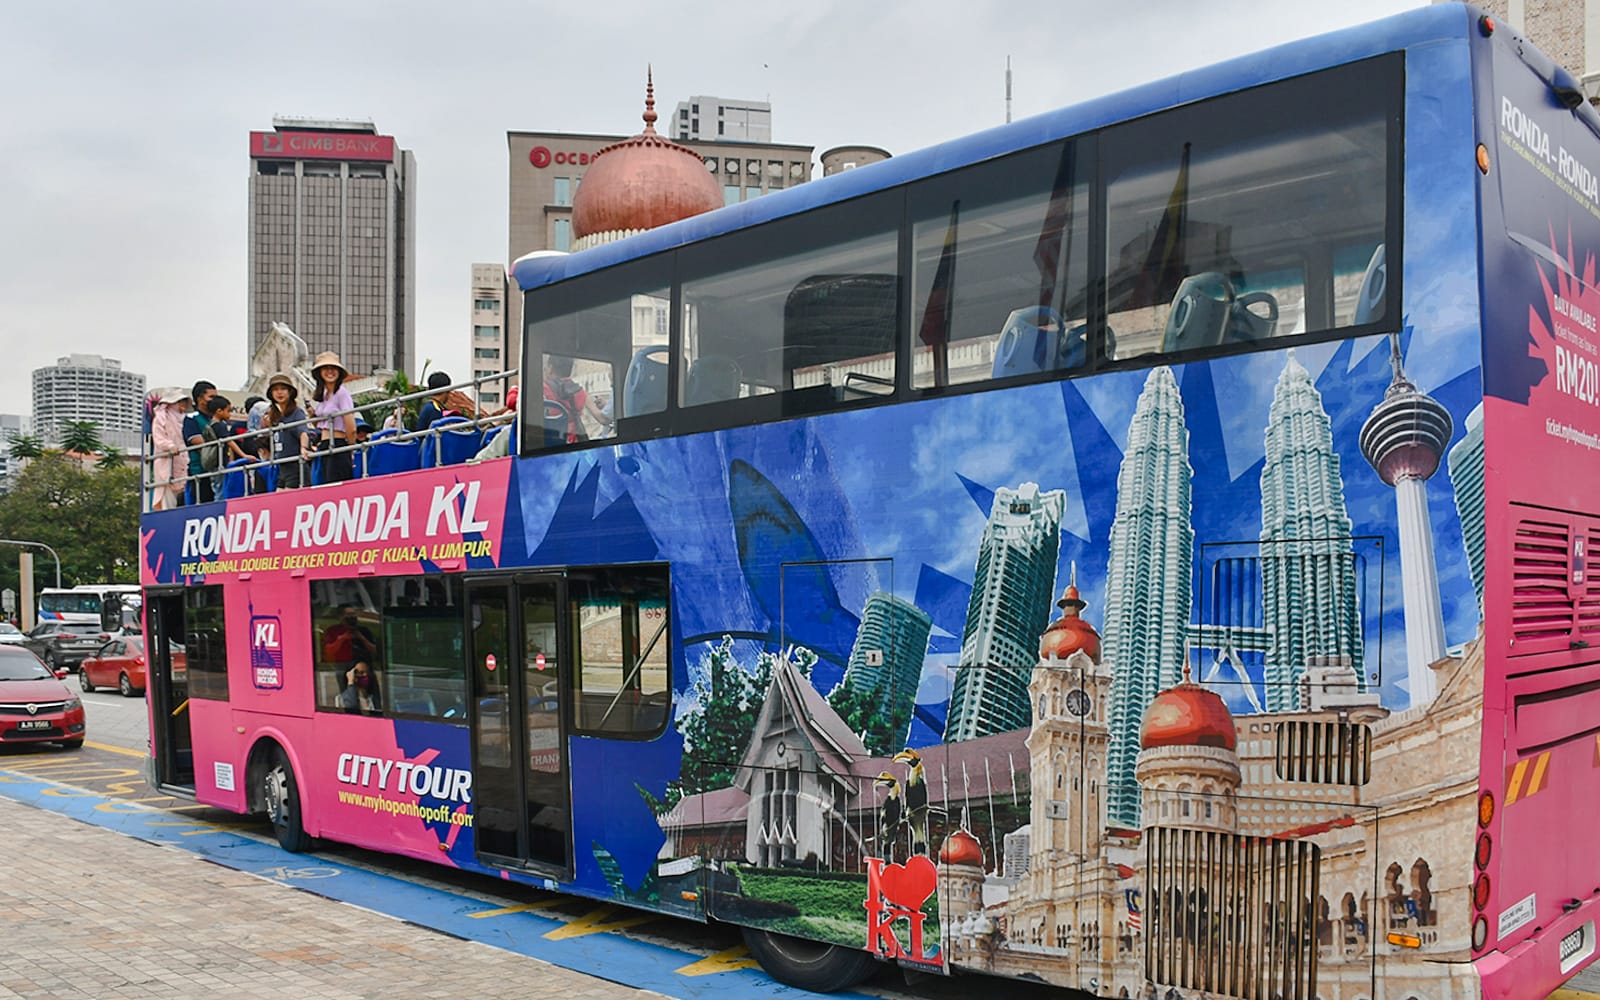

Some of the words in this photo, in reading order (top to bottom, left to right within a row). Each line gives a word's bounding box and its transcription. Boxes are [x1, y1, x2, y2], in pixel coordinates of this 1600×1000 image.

[289, 136, 333, 151] CIMB
[335, 138, 380, 152] BANK
[1555, 344, 1599, 407] RM20!
[425, 480, 489, 537] KL
[180, 562, 198, 576] THE
[197, 559, 239, 575] ORIGINAL
[240, 557, 280, 572] DOUBLE
[282, 553, 324, 569] DECKER
[327, 550, 358, 567] TOUR
[361, 549, 381, 564] OF
[382, 545, 428, 563] KUALA
[431, 540, 492, 560] LUMPUR
[255, 623, 279, 647] KL
[337, 753, 393, 790] CITY
[396, 761, 473, 803] TOUR
